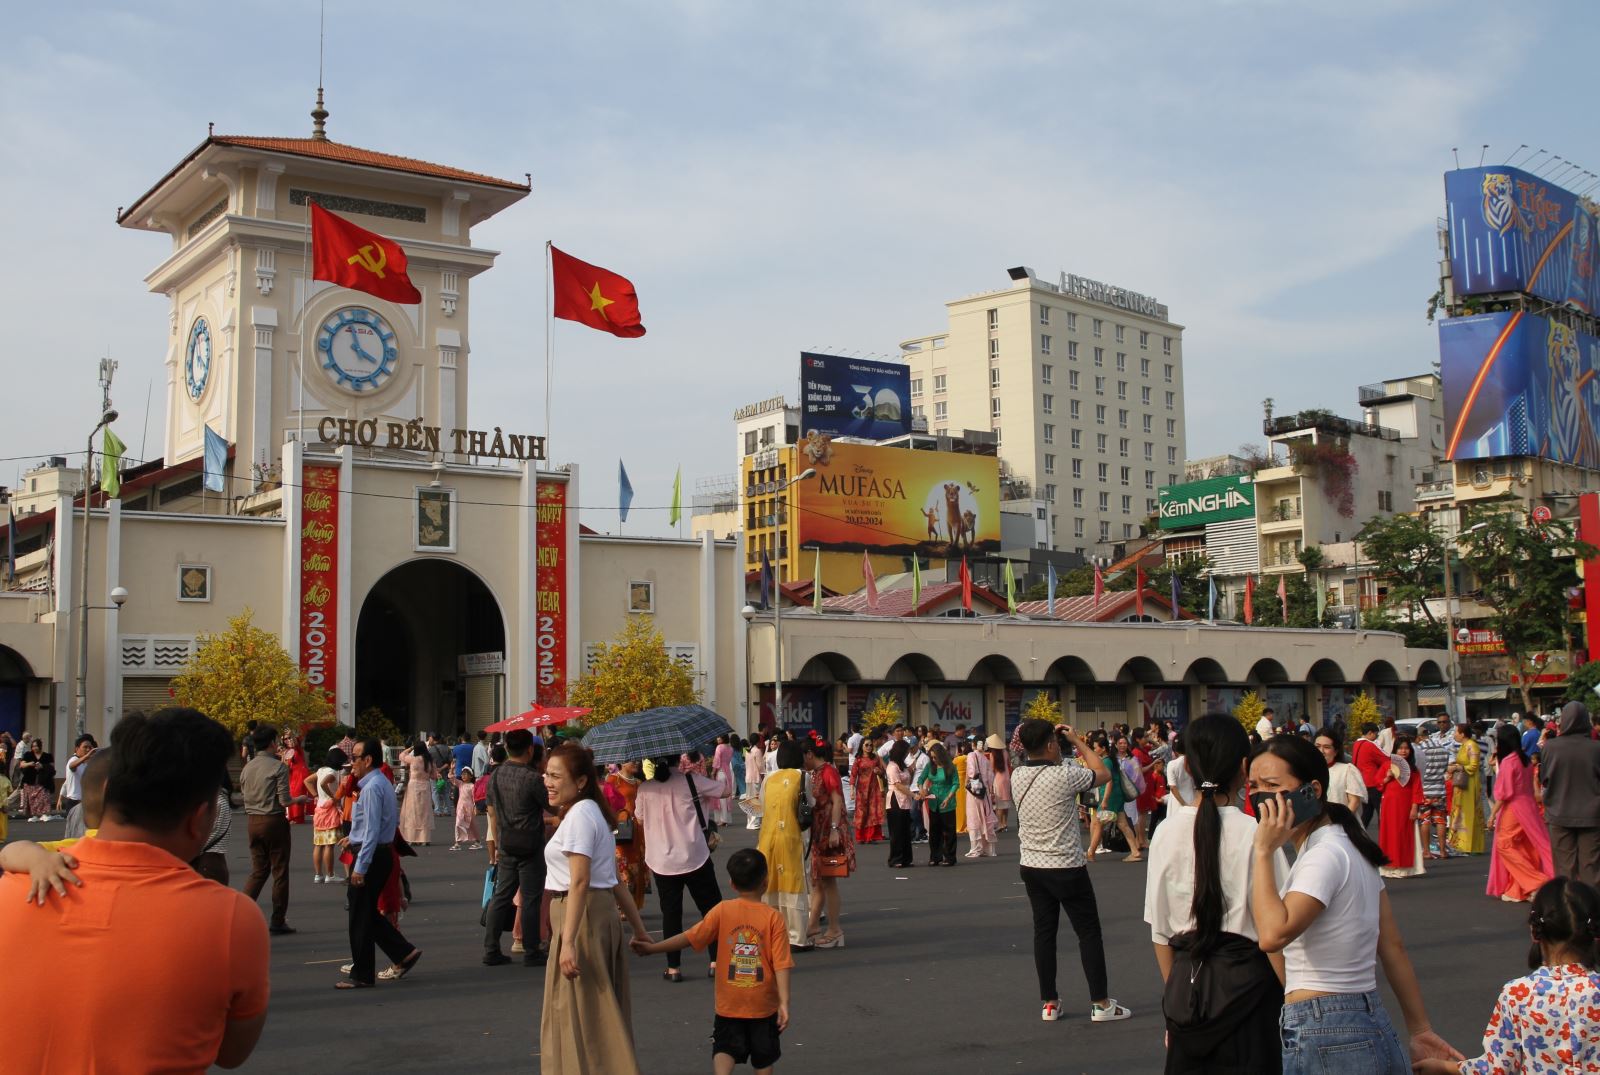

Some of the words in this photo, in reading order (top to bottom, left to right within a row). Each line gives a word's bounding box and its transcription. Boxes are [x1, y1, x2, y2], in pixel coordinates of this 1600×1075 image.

[1516, 181, 1561, 230] Tiger
[1059, 271, 1109, 303] LIBERTY
[1110, 285, 1160, 316] CENTRAL
[759, 395, 785, 415] HOTEL
[317, 416, 378, 449] CHỢ
[386, 416, 442, 453] BẾN
[450, 426, 546, 461] THÀNH
[819, 472, 907, 500] MUFASA
[303, 491, 332, 512] Chúc
[536, 503, 563, 524] HAPPY
[302, 520, 336, 543] Mừng
[303, 553, 331, 572] Năm
[537, 547, 559, 568] NEW
[303, 584, 331, 607] Mới
[536, 591, 561, 614] YEAR
[306, 611, 326, 685] 2025
[537, 616, 556, 685] 2025
[766, 692, 813, 724] Vikki
[931, 692, 972, 721] Vikki
[1143, 692, 1178, 719] Vikki
